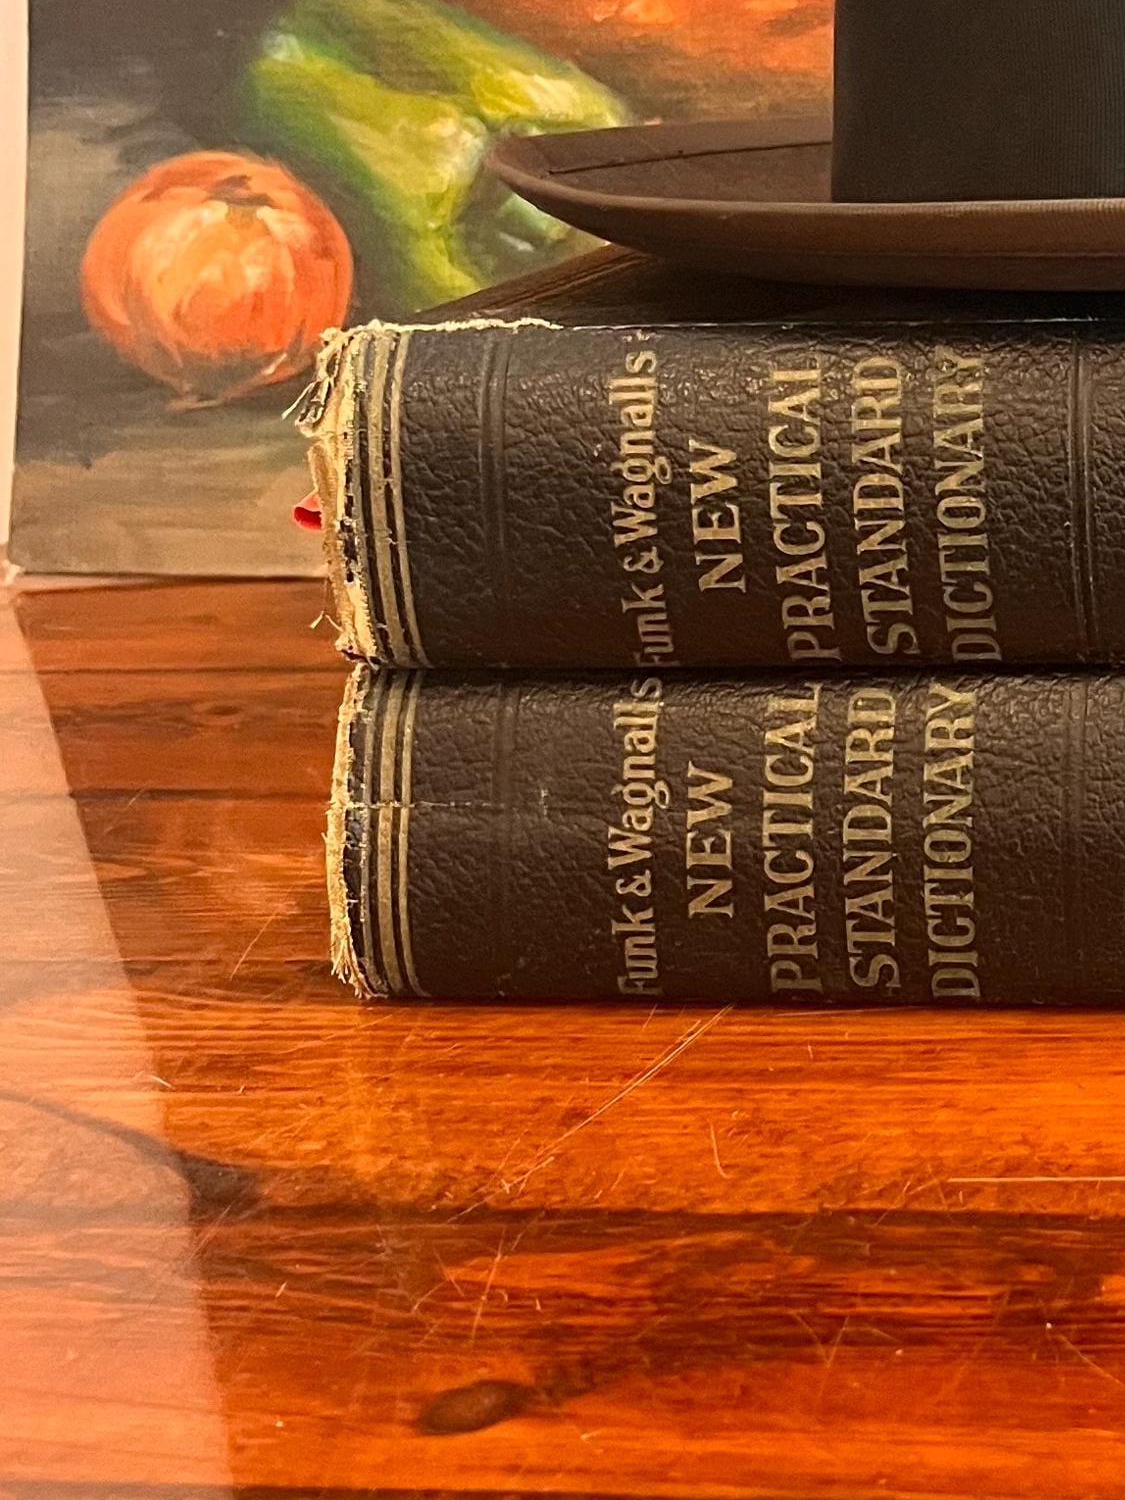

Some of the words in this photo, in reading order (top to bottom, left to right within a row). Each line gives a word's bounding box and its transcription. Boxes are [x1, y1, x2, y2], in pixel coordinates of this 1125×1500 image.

[608, 350, 672, 548] Wagnalls
[688, 439, 747, 593] NEW
[851, 356, 921, 657] STANDARD
[933, 346, 1003, 662] DICTIONARY
[621, 584, 680, 667] Funk
[623, 546, 664, 575] &
[607, 676, 670, 871] Wagnalls
[686, 760, 734, 919] NEW
[762, 683, 823, 995] PRACTICAL
[842, 686, 900, 997] STANDARD
[922, 682, 982, 999] DICTIONARY
[611, 904, 664, 996] Funk
[615, 869, 653, 898] &
